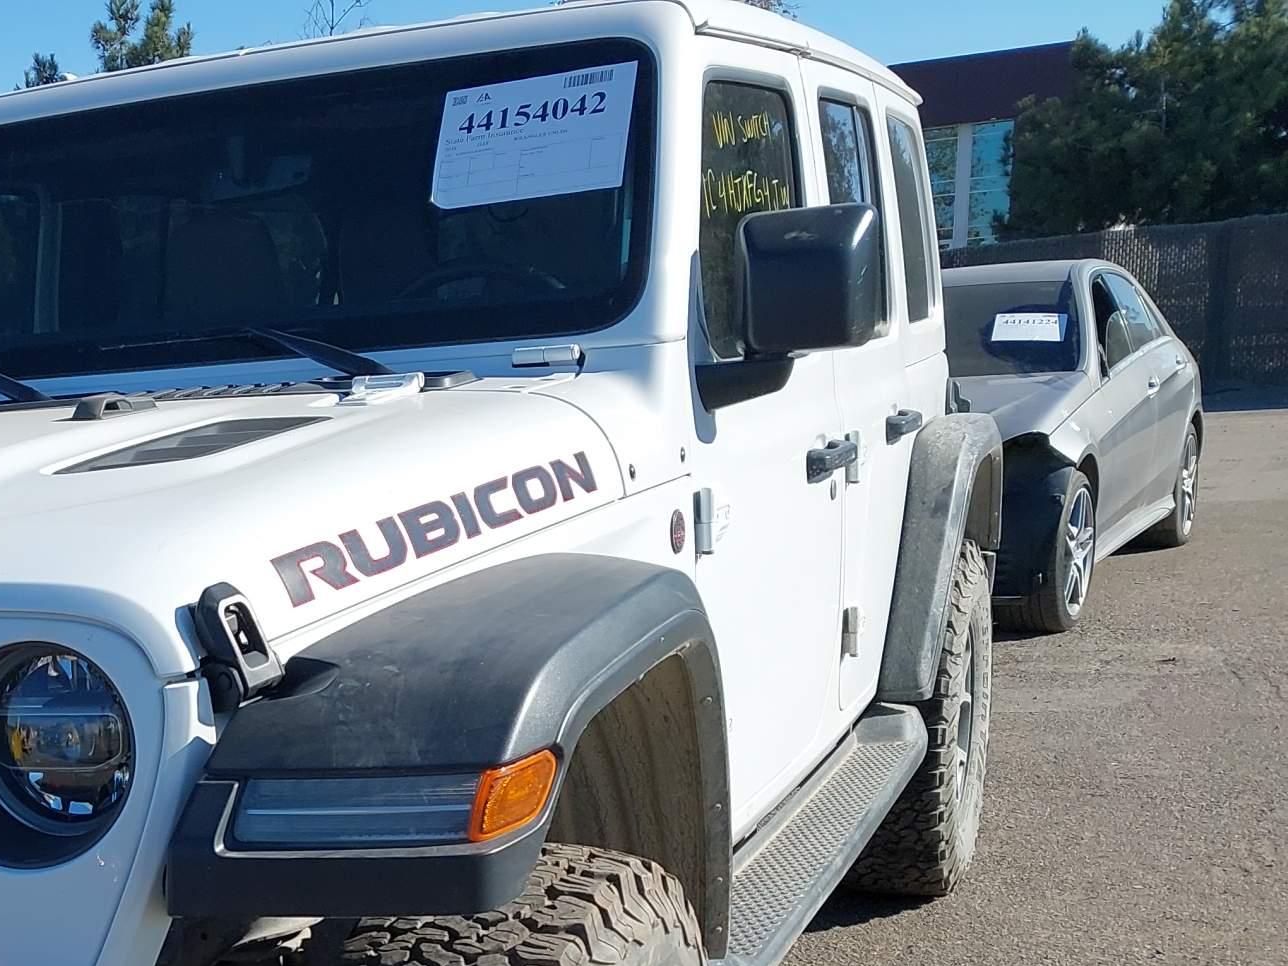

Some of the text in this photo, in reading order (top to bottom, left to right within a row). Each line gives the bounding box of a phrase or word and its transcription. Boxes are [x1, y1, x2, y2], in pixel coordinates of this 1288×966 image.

[459, 91, 607, 134] 44154042
[712, 111, 736, 149] VIN
[1002, 318, 1058, 326] 44141224
[269, 450, 598, 607] RUBICON
